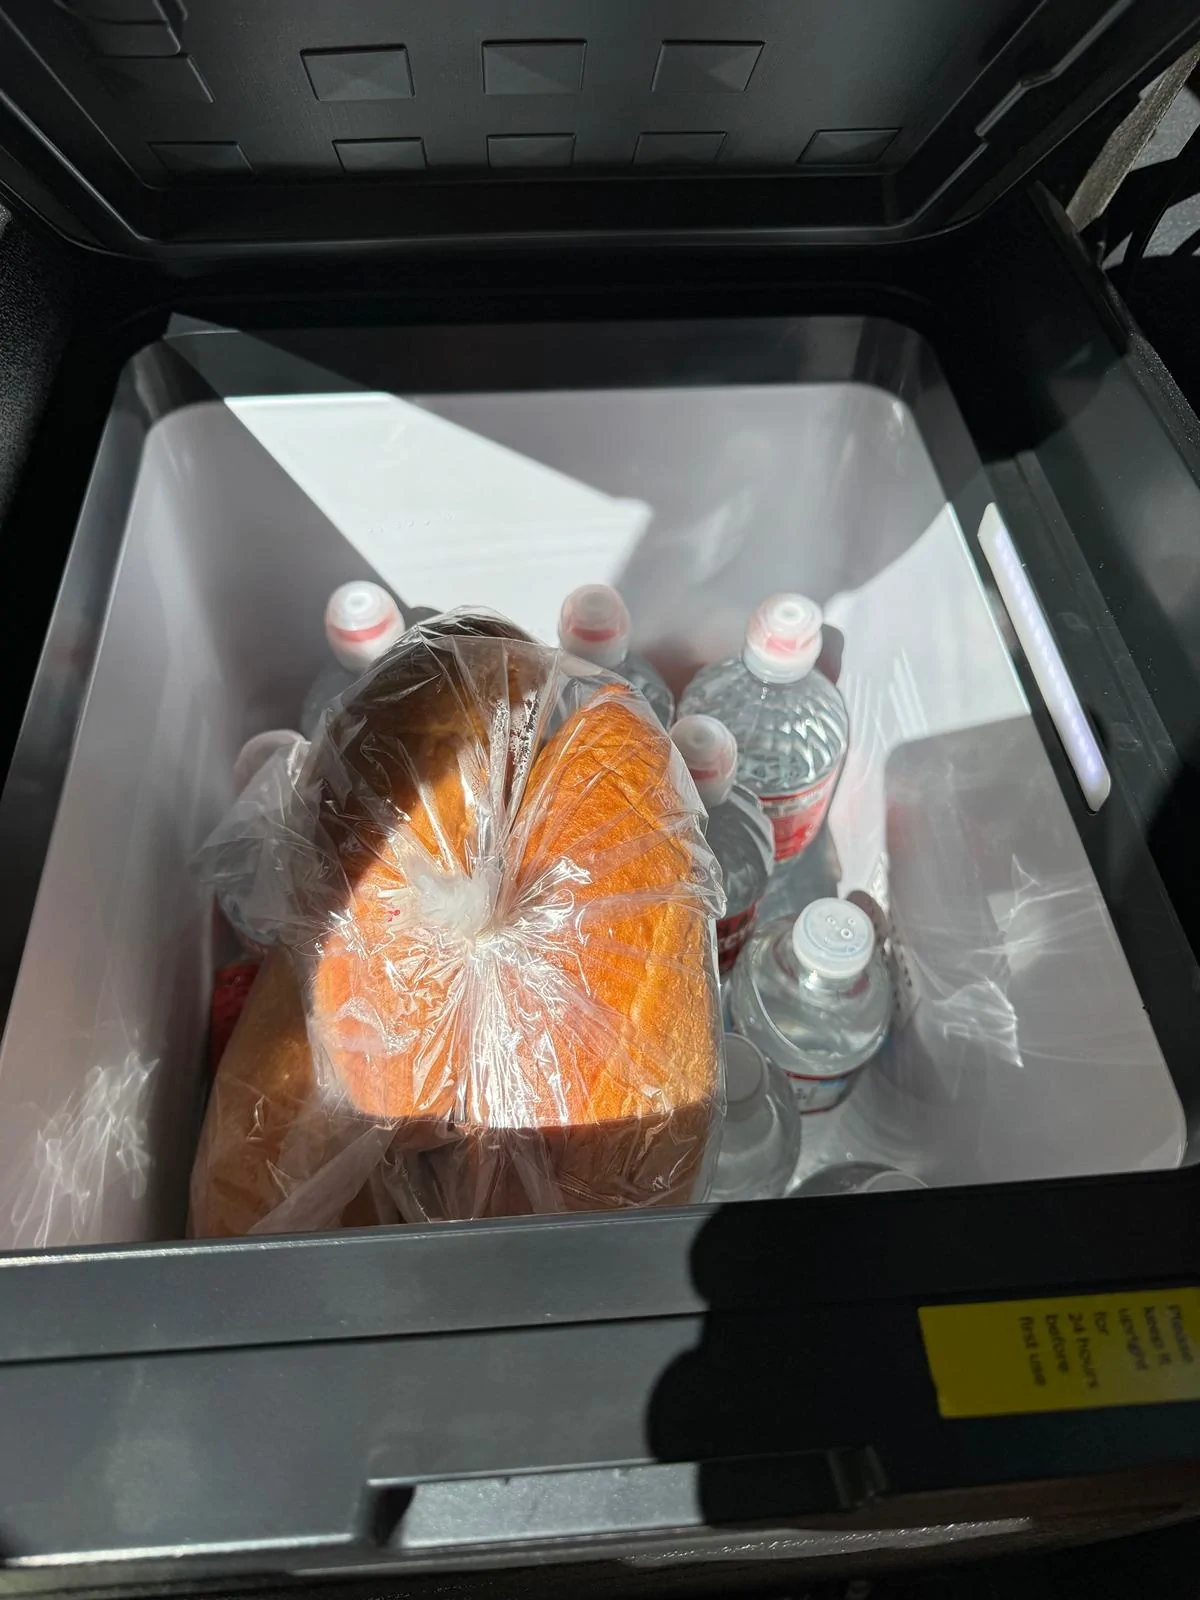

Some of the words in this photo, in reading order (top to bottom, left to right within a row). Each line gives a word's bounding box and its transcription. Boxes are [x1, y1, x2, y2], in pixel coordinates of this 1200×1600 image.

[1018, 1316, 1039, 1349] first
[1029, 1353, 1046, 1387] use
[1045, 1314, 1069, 1372] before
[1068, 1312, 1086, 1333] 24
[1094, 1311, 1109, 1336] for
[1117, 1308, 1149, 1370] upright
[1144, 1306, 1164, 1349] keep
[1159, 1353, 1172, 1366] it
[1167, 1304, 1194, 1363] Please
[1076, 1338, 1099, 1388] hours
